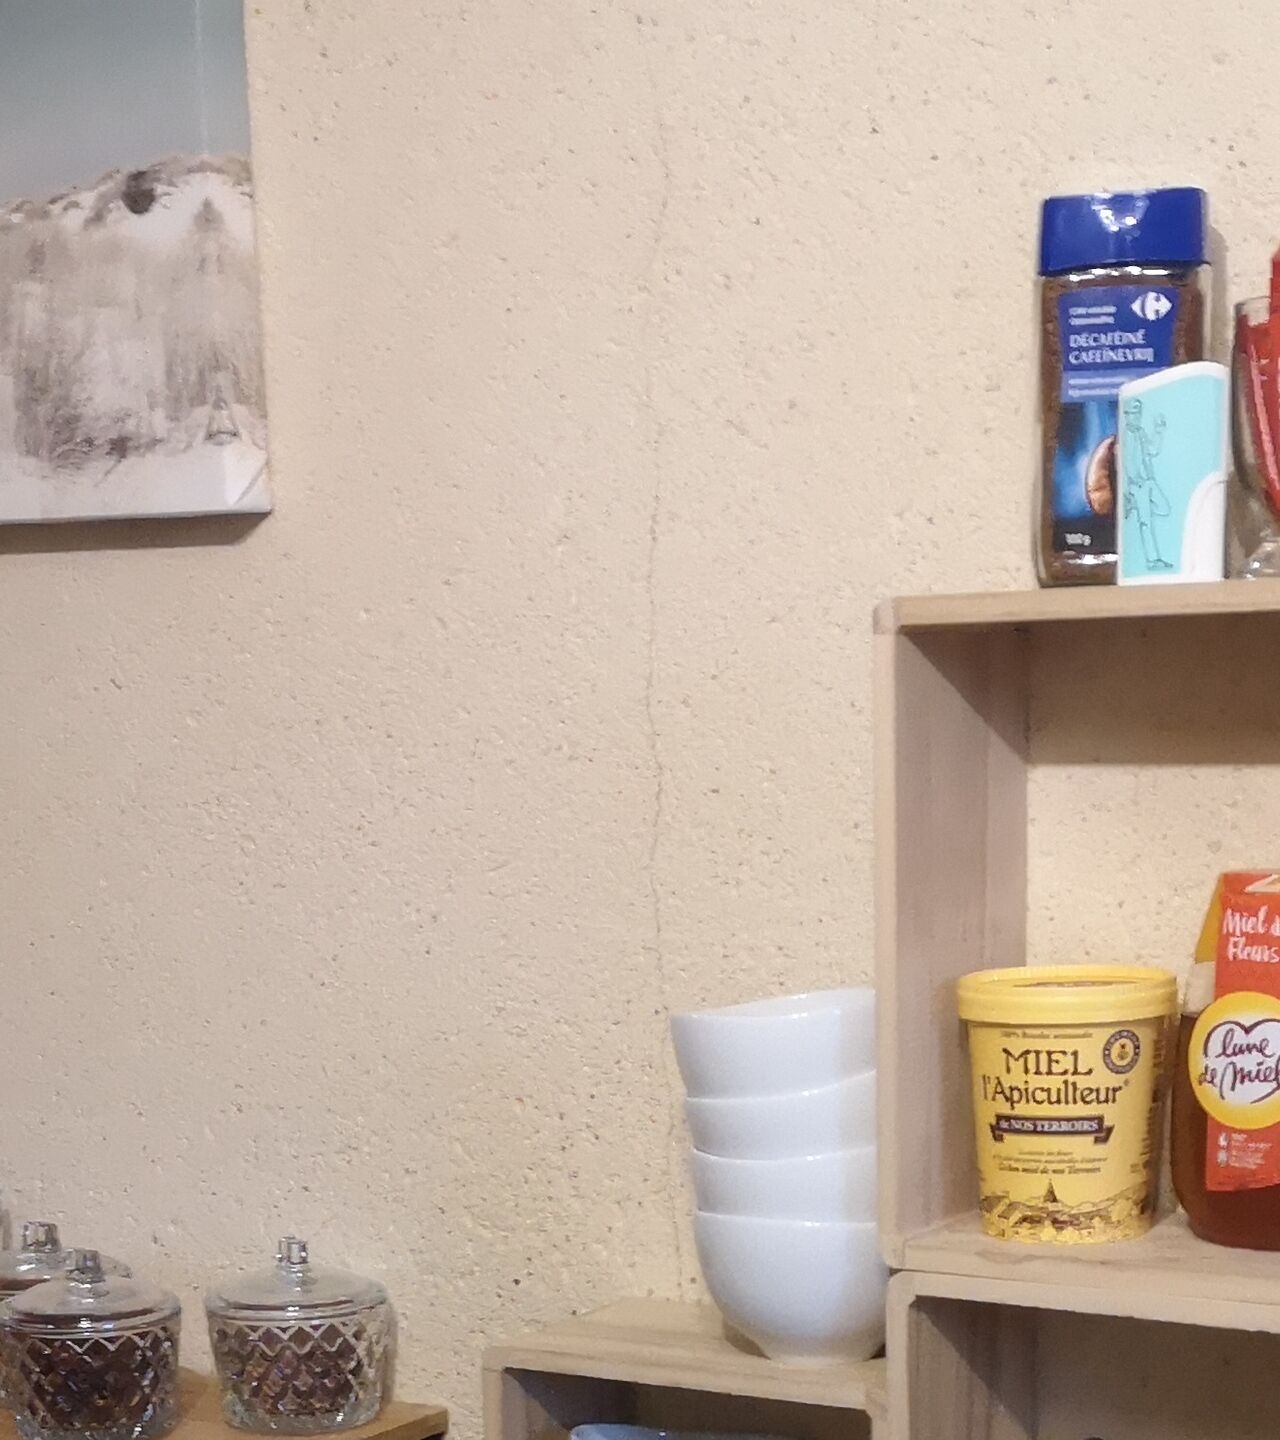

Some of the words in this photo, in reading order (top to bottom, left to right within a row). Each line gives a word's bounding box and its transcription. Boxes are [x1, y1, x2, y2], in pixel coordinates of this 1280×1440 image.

[1222, 904, 1269, 937] Miel
[1226, 936, 1280, 964] Fleurs
[1215, 1027, 1276, 1059] lune
[1002, 1047, 1094, 1077] MIEL
[982, 1074, 1123, 1111] l'Apiculteur
